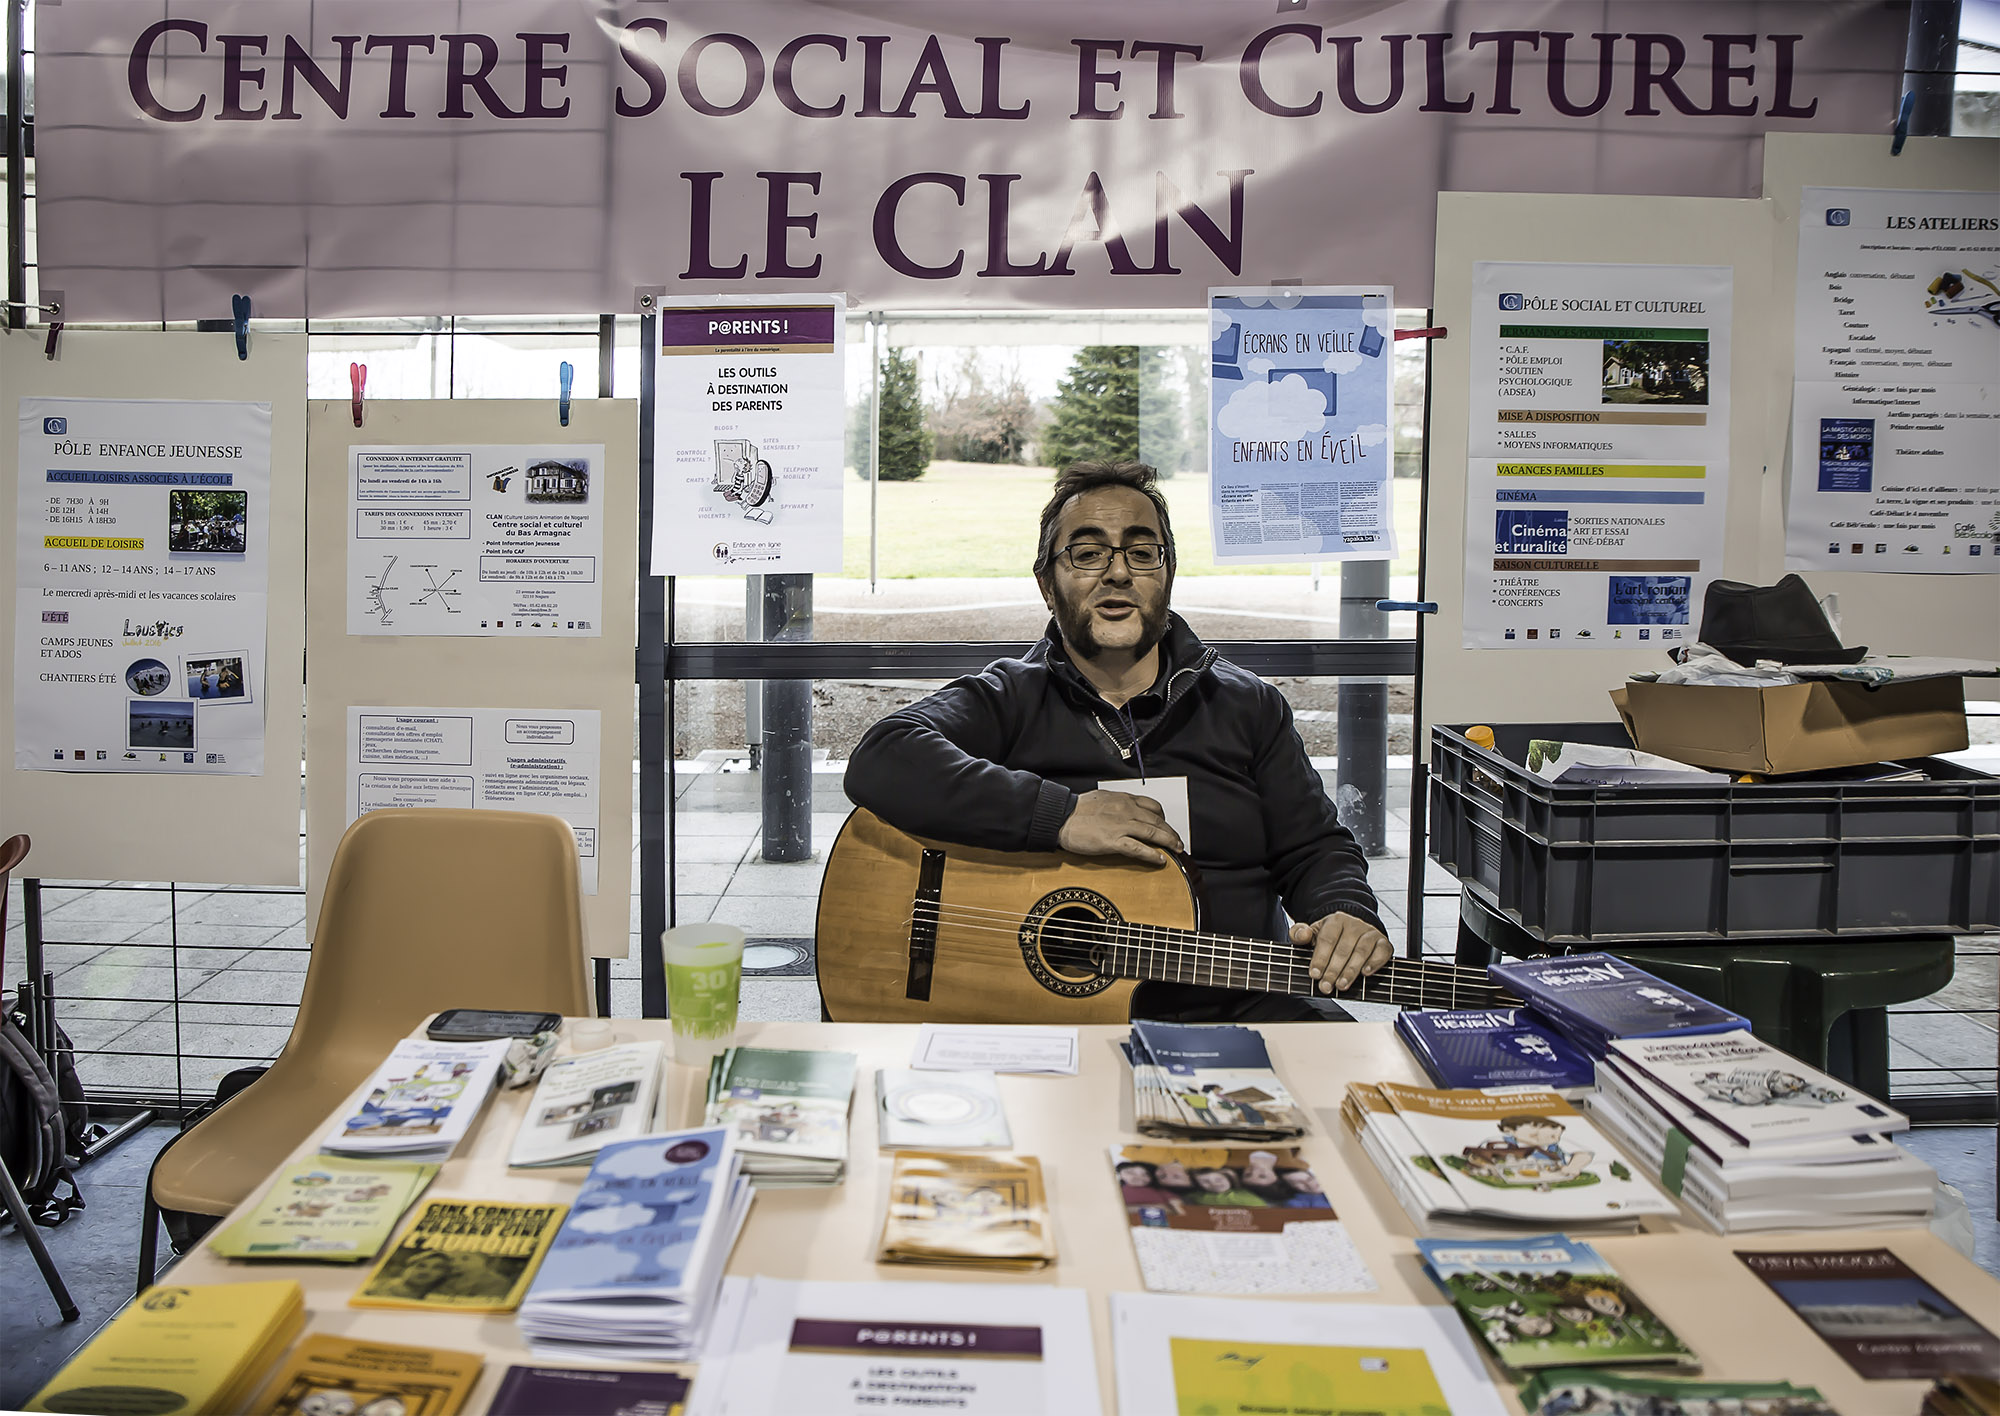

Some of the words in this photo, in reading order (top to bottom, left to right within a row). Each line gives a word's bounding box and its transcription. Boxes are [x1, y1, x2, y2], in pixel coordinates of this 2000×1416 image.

[127, 18, 571, 124] CENTRE
[615, 16, 1031, 119] SOCIAL
[1069, 38, 1203, 121] ET
[1239, 23, 1819, 119] CULTUREL
[678, 170, 823, 280] LE
[871, 168, 1255, 279] CLAN
[1886, 216, 1915, 229] LES
[1919, 217, 1999, 231] ATELIERS
[1523, 296, 1558, 311] PÔLE
[1562, 300, 1611, 312] SOCIAL
[1615, 301, 1632, 312] ET
[1635, 301, 1706, 314] CULTUREL
[708, 320, 781, 335] P@RENTS
[1244, 330, 1288, 354] ÉCRANS
[1296, 333, 1310, 353] EN
[1505, 346, 1529, 354] C.A.F.
[1505, 356, 1528, 364] PÔLE
[1530, 357, 1563, 365] EMPLOI
[718, 367, 735, 378] LES
[738, 367, 776, 377] OUTILS
[1505, 367, 1543, 375] SOUTIEN
[1498, 377, 1572, 387] PSYCHOLOGIQUE
[706, 382, 715, 394] À
[718, 383, 787, 394] DESTINATION
[712, 400, 732, 411] DES
[735, 400, 782, 411] PARENTS
[1498, 412, 1523, 421] MISE
[1526, 410, 1534, 421] À
[1535, 412, 1600, 422] DISPOSITION
[1504, 430, 1537, 438] SALLES
[54, 439, 91, 455] PÔLE
[99, 443, 165, 457] ENFANCE
[169, 444, 242, 458] JEUNESSE
[1233, 440, 1289, 463] ENFANTS
[1298, 440, 1313, 461] EN
[1504, 441, 1541, 449] MOYENS
[1542, 442, 1613, 451] INFORMATIQUES
[1497, 466, 1552, 475] VACANCES
[1554, 466, 1604, 475] FAMILLES
[47, 473, 91, 482] ACCUEIL
[93, 473, 130, 483] LOISIRS
[132, 472, 179, 484] ASSOCIÉS
[181, 473, 188, 484] À
[191, 473, 232, 485] L'ÉCOLE
[89, 497, 95, 505] À
[1496, 490, 1537, 501] CINÉMA
[88, 506, 95, 515] À
[96, 507, 109, 515] 14H
[61, 516, 83, 524] 16H15
[88, 515, 95, 524] À
[96, 517, 116, 525] 18H30
[1574, 517, 1609, 525] SORTIES
[1611, 518, 1665, 526] NATIONALES
[1511, 524, 1567, 537] Cinéma
[1605, 528, 1629, 536] ESSAI
[44, 537, 88, 547] ACCUEIL
[91, 539, 104, 548] DE
[106, 539, 143, 548] LOISIRS
[732, 541, 756, 549] Enfance
[768, 541, 781, 549] ligne
[1495, 542, 1509, 552] et
[1513, 540, 1566, 553] ruralité
[1573, 536, 1625, 546] CINÉ-DÉBAT
[1494, 560, 1531, 569] SAISON
[1533, 561, 1599, 570] CULTURELLE
[1499, 577, 1539, 586] THÉÂTRE
[42, 587, 53, 596] Le
[55, 587, 91, 597] mercredi
[93, 588, 136, 600] après-midi
[138, 591, 146, 599] et
[148, 590, 160, 599] les
[200, 591, 236, 601] scolaires
[1498, 588, 1561, 597] CONFÉRENCES
[1648, 586, 1686, 595] roman
[1498, 599, 1544, 607] CONCERTS
[42, 611, 68, 623] L'ÉTÉ
[40, 637, 75, 647] CAMPS
[77, 638, 113, 648] JEUNES
[40, 649, 51, 658] ET
[53, 649, 82, 659] ADOS
[39, 673, 96, 683] CHANTIERS
[99, 671, 117, 683] ÉTÉ
